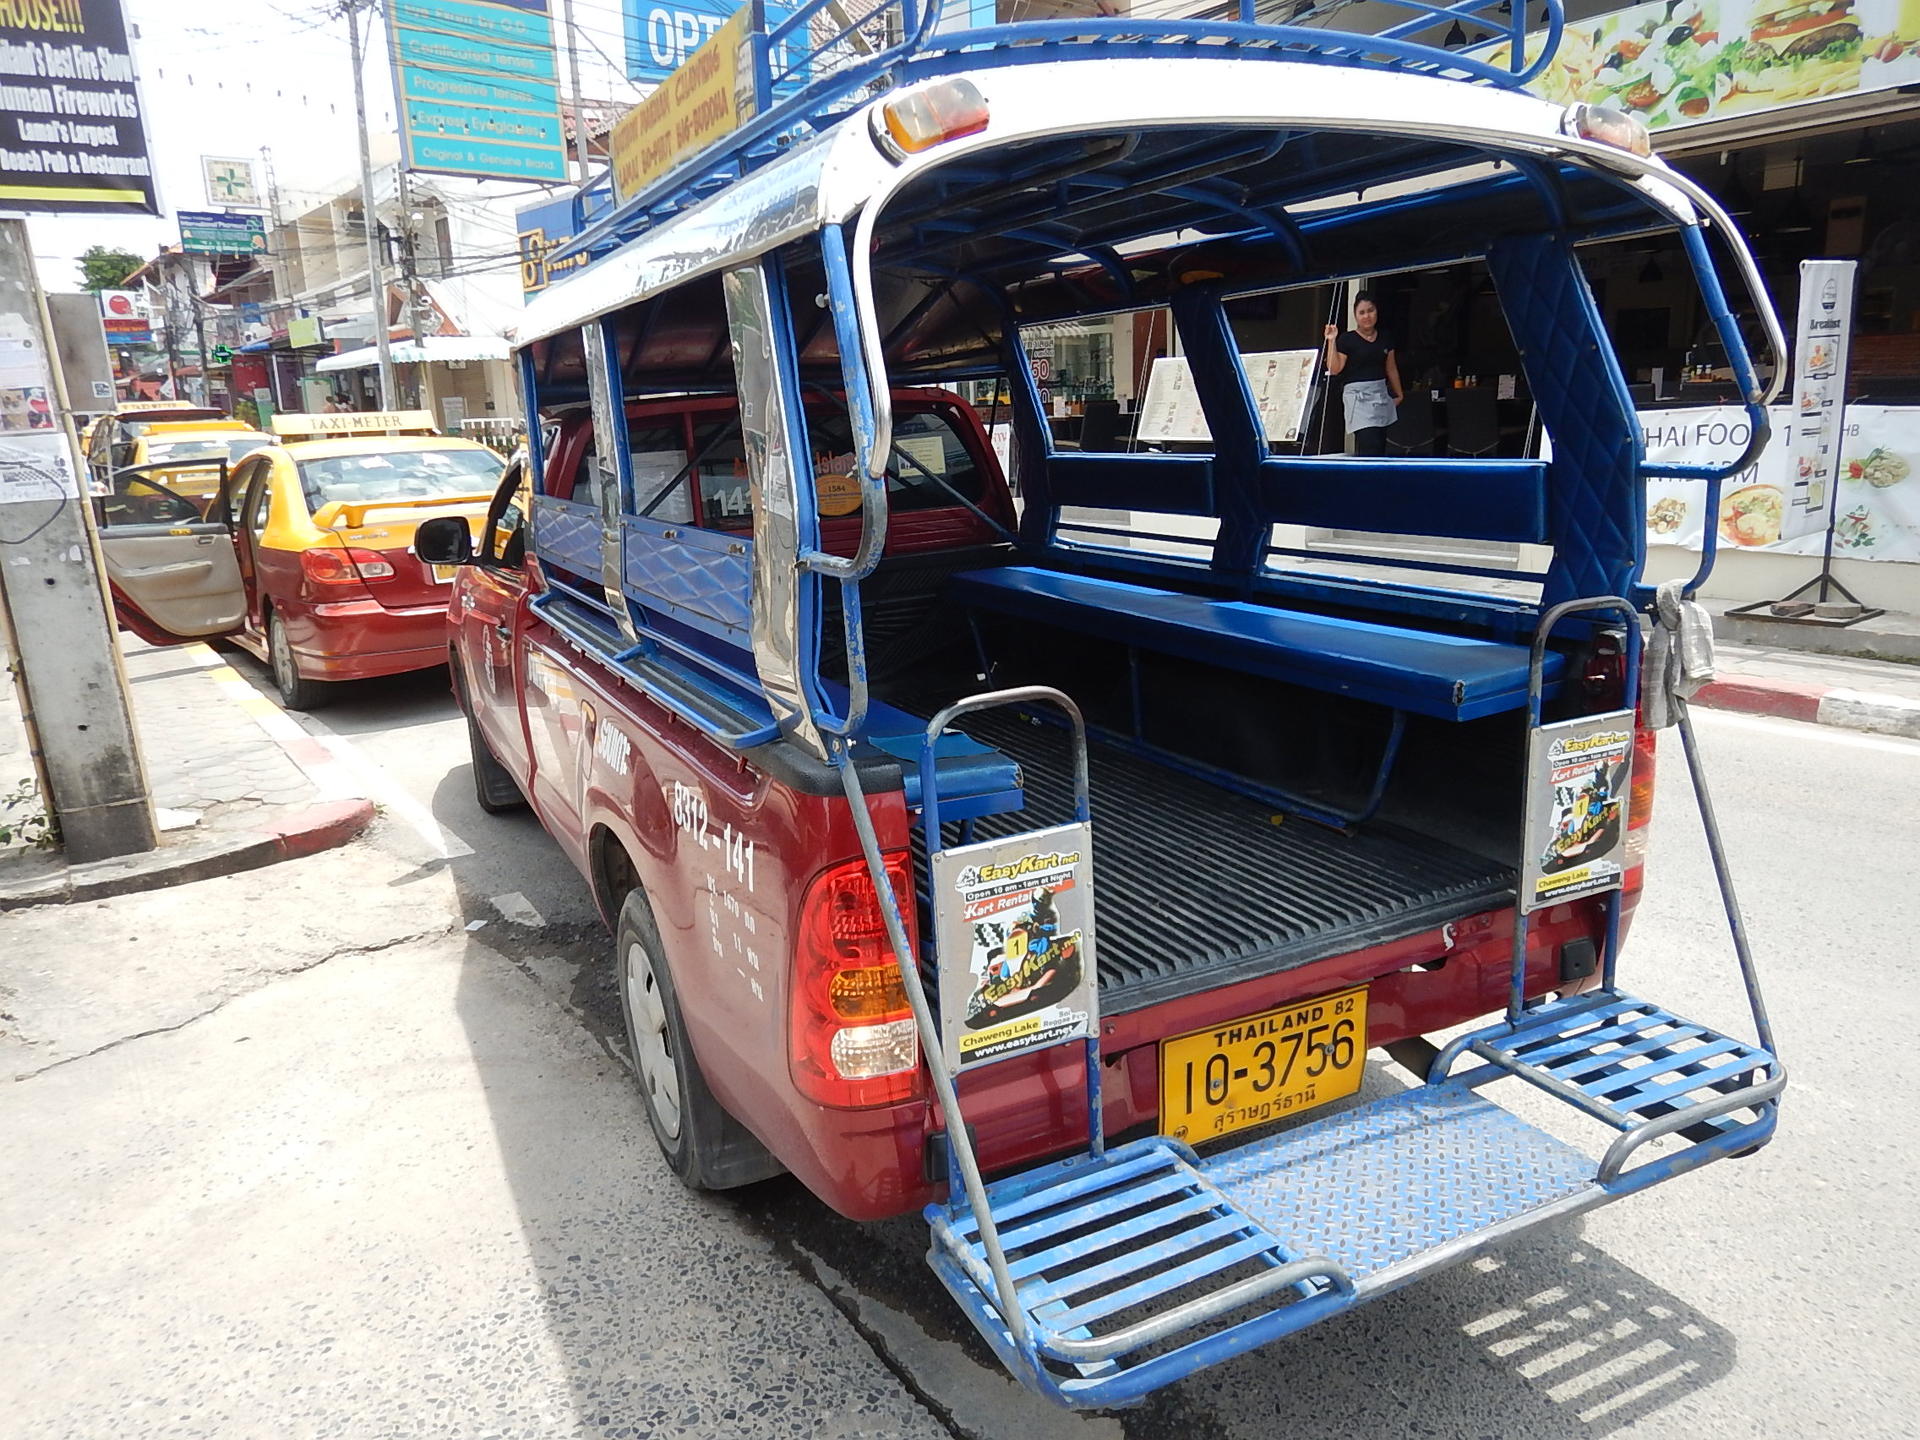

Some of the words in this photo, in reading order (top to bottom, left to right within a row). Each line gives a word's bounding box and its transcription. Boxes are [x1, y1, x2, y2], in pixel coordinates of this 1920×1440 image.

[42, 42, 77, 79] Best
[72, 45, 100, 81] Fire
[97, 46, 134, 82] Show
[414, 76, 488, 96] Progressive
[52, 84, 137, 118] Fireworks
[17, 118, 69, 143] Lamai's
[68, 121, 119, 147] Largest
[41, 150, 69, 173] Pub
[69, 154, 81, 174] &
[78, 152, 150, 176] Restaurant
[423, 147, 463, 161] Original
[467, 152, 475, 161] &
[480, 154, 522, 166] Genuine
[1696, 423, 1750, 446] FOO
[1551, 769, 1571, 782] Kart
[967, 891, 991, 900] Open
[993, 887, 1003, 895] 10
[1050, 872, 1072, 883] Night
[1572, 871, 1589, 880] Lake
[964, 904, 994, 920] Kart
[997, 891, 1032, 910] Rental
[1013, 939, 1019, 956] 1
[963, 1027, 1013, 1047] Chaweng
[1014, 1020, 1039, 1034] Lake
[1214, 1006, 1324, 1048] THAILAND
[1334, 997, 1355, 1016] 82
[974, 1024, 1075, 1059] www.easykart.net
[1186, 1018, 1355, 1116] 10-3756
[1214, 1083, 1317, 1133] สุราษฎร์ธานี
